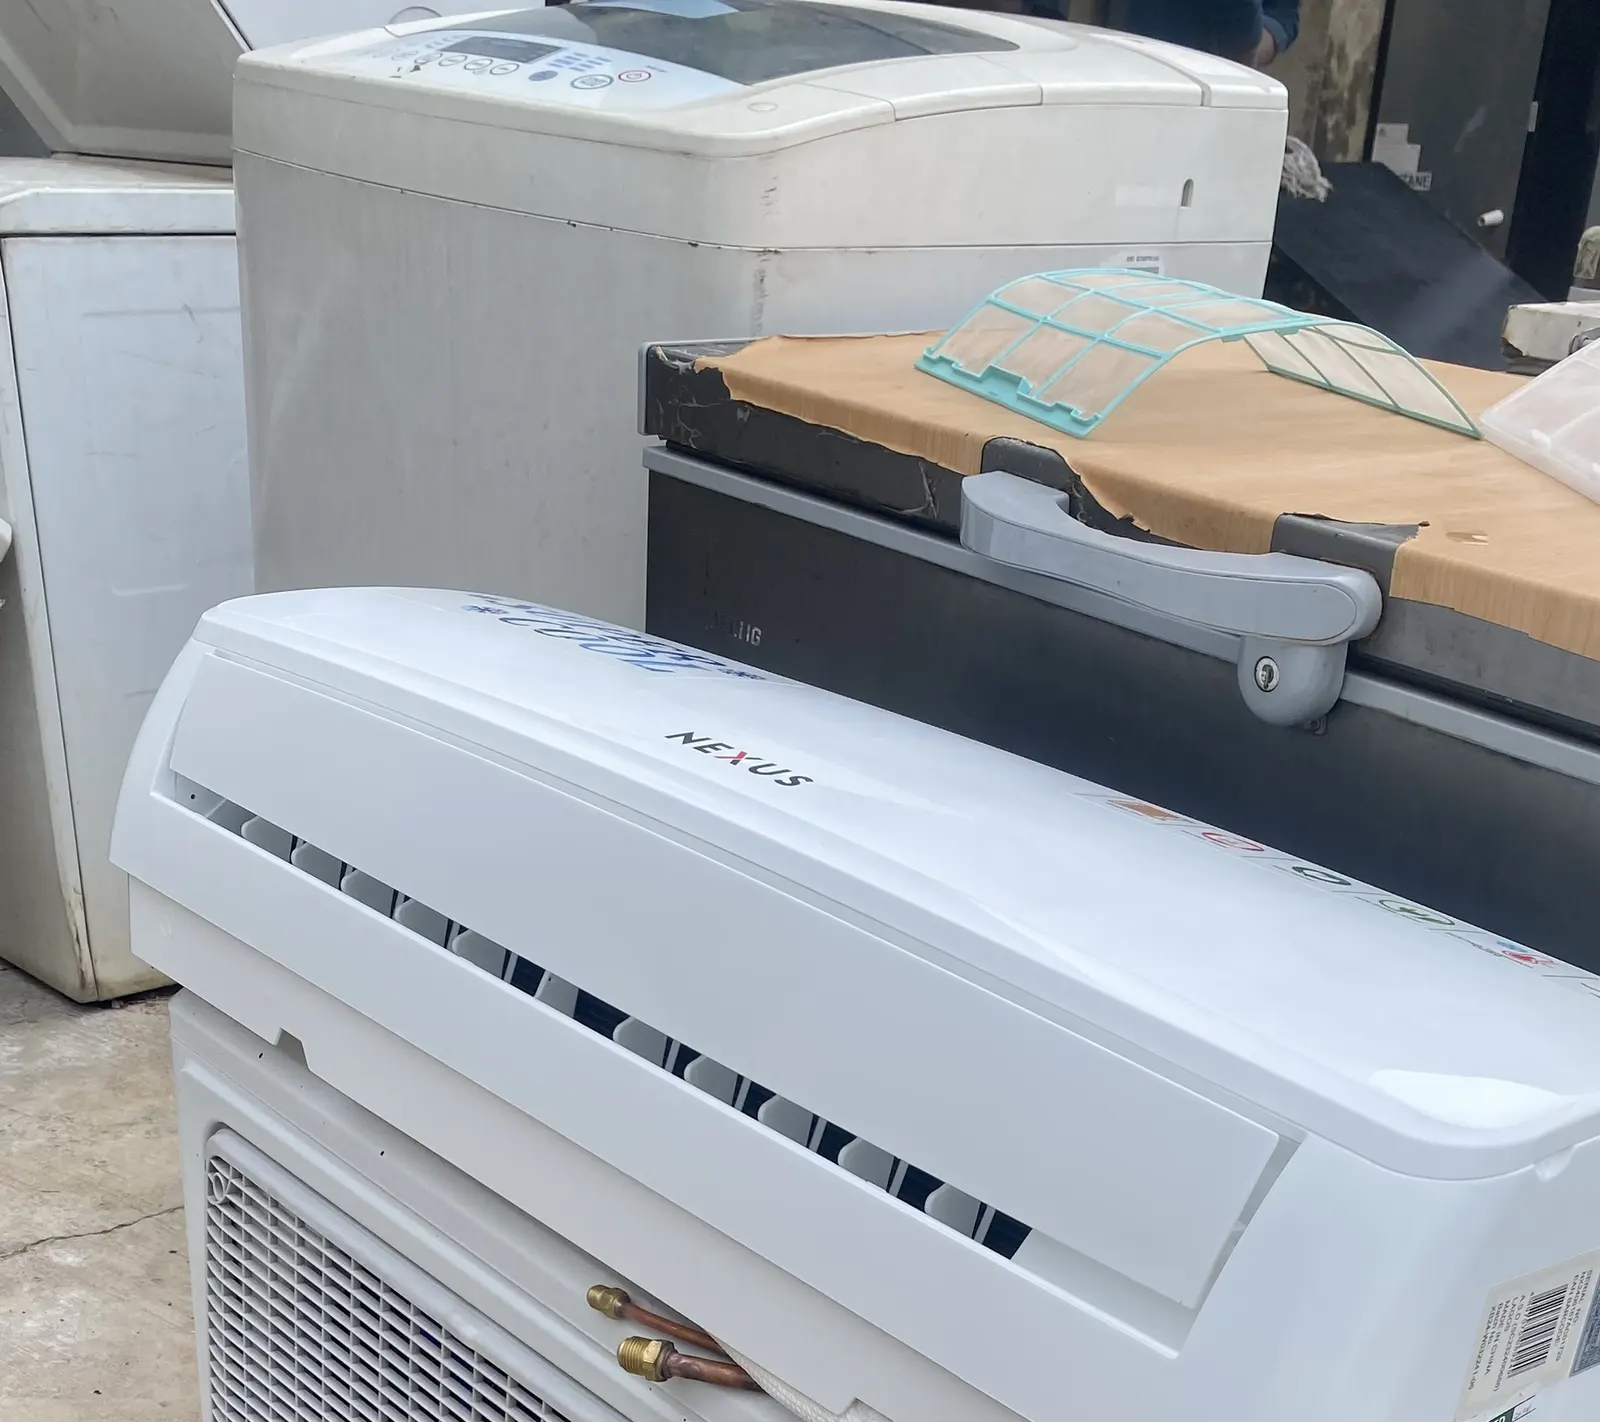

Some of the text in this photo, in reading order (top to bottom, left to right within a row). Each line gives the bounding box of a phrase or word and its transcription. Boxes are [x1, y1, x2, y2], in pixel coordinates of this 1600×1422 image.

[499, 617, 712, 673] COOL
[665, 731, 815, 788] NEXUS
[1497, 1299, 1511, 1330] MADE
[1503, 1296, 1519, 1332] LAGOS
[1483, 1343, 1498, 1375] CHINA
